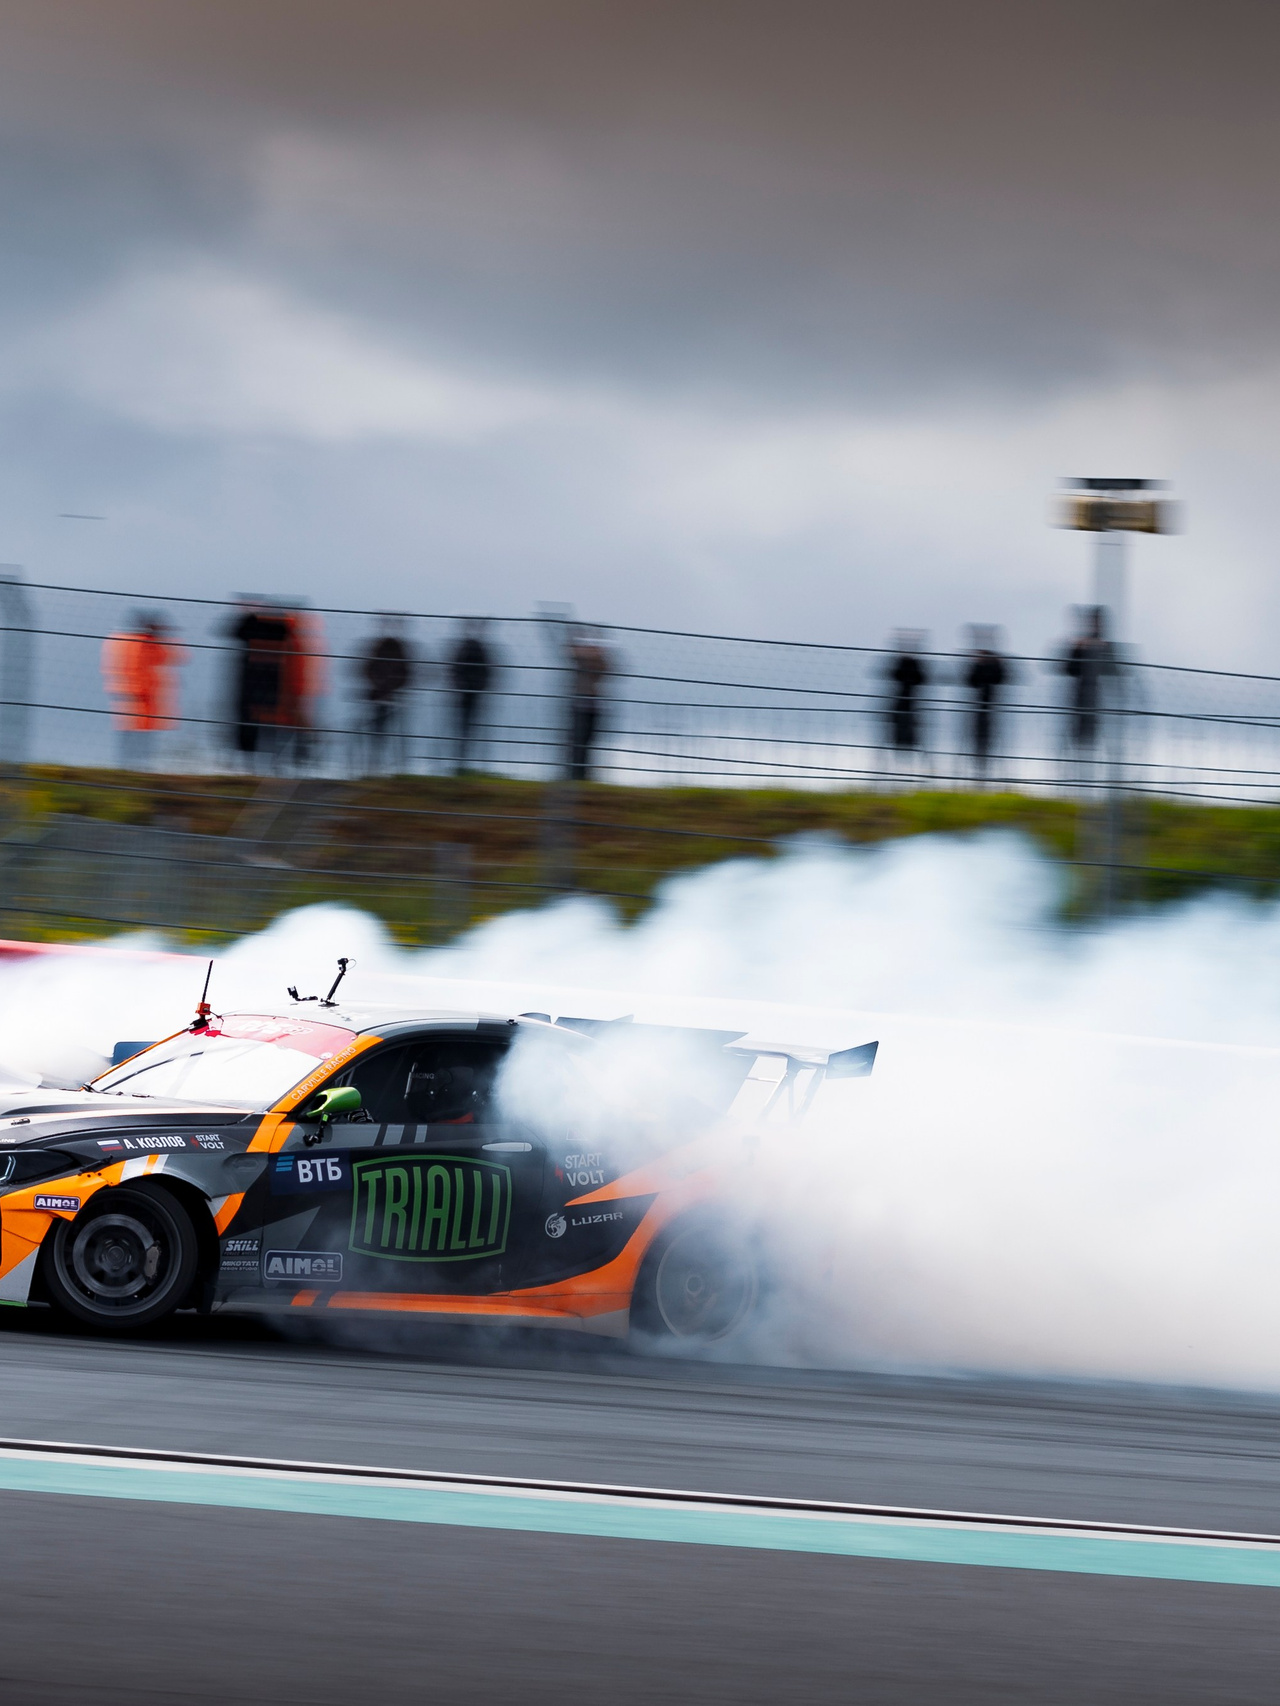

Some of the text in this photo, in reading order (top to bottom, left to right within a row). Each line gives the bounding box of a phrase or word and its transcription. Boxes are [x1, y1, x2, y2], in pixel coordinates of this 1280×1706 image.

[291, 1046, 357, 1101] CARVILLE RACING
[136, 1136, 186, 1149] КОЗЛОВ
[195, 1134, 220, 1142] START
[200, 1142, 225, 1150] VOLT
[565, 1152, 602, 1169] START
[297, 1158, 342, 1183] ВТБ
[566, 1170, 605, 1186] VOLT
[37, 1197, 79, 1210] AIMOL
[362, 1165, 501, 1250] TRIALLI
[572, 1212, 624, 1226] LUZAR
[225, 1240, 259, 1252] SKILL
[267, 1257, 339, 1276] AIMOL
